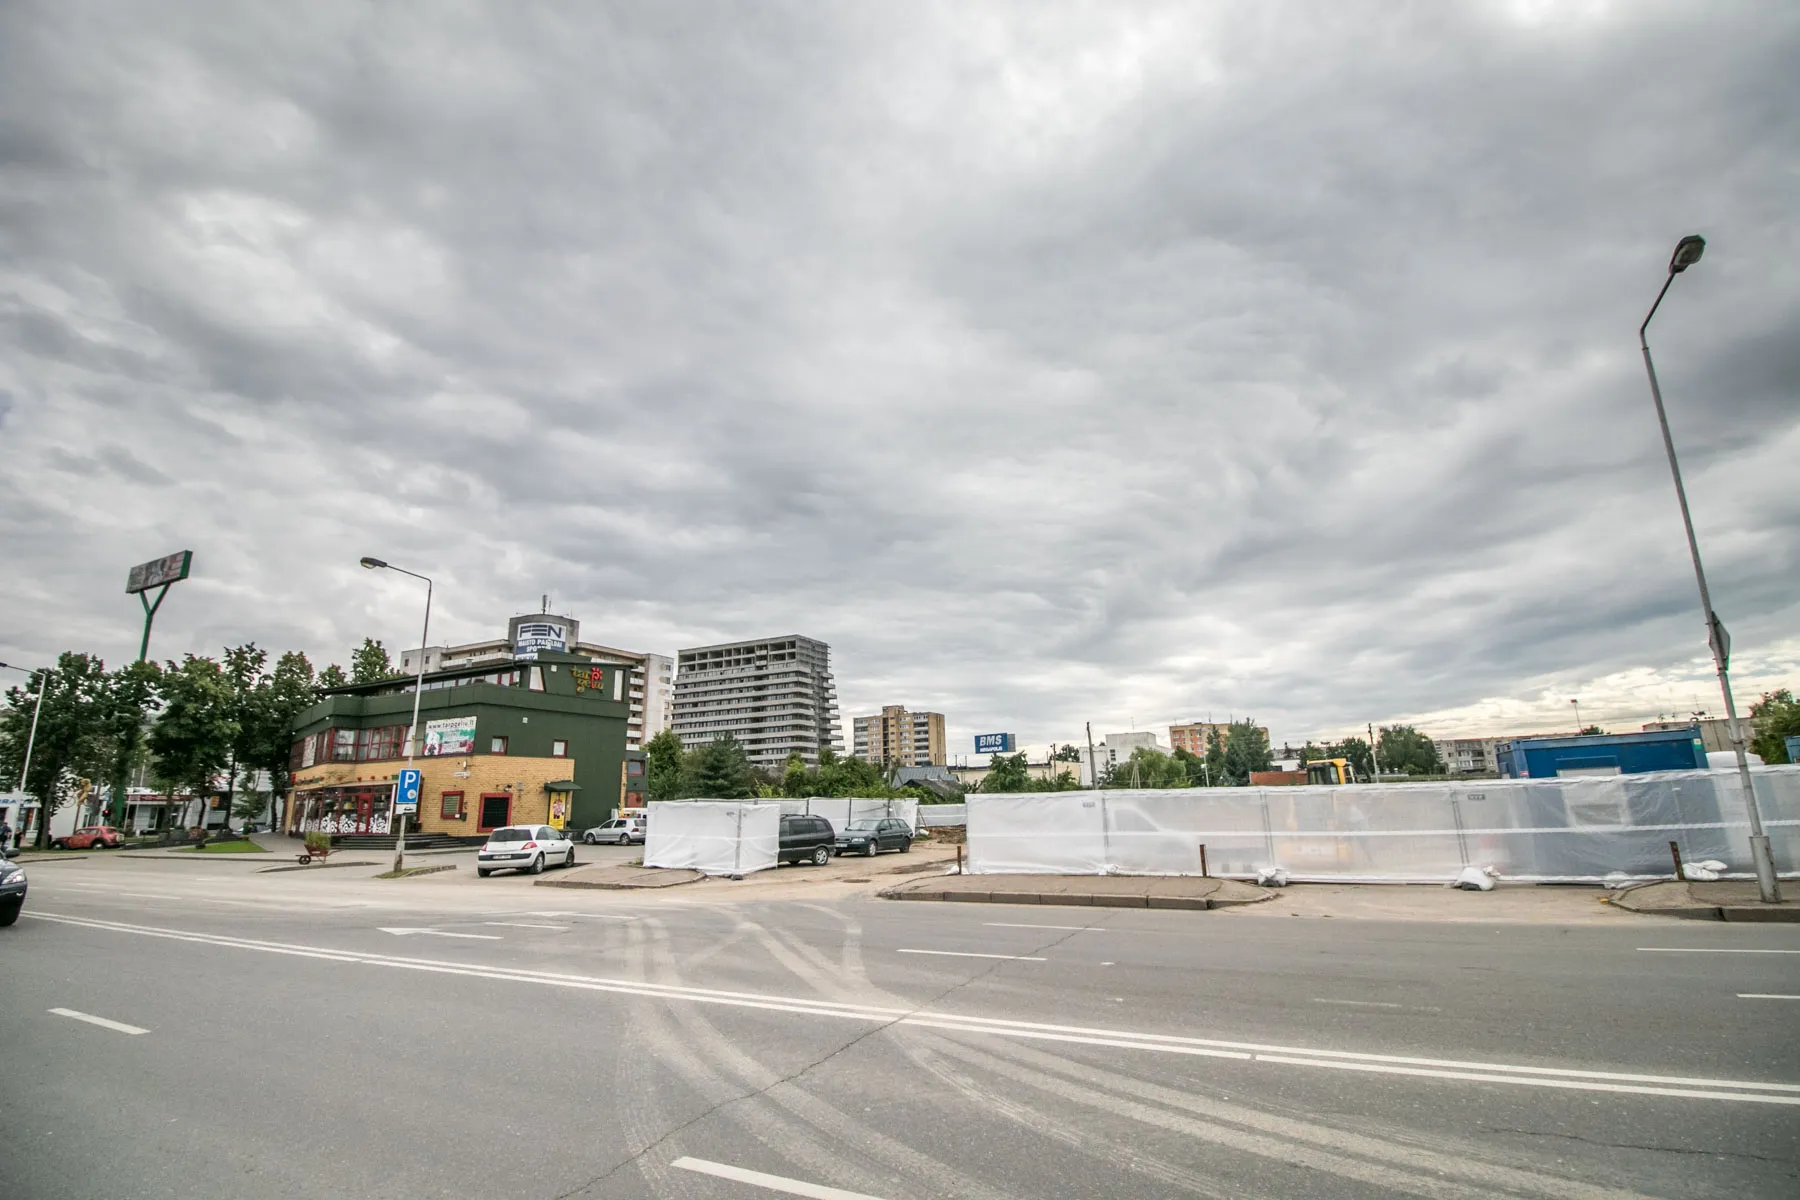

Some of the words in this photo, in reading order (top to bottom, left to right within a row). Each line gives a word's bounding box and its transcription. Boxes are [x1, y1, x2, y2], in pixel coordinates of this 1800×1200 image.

[520, 625, 562, 638] FEN
[537, 640, 562, 648] PAPLDAI
[980, 735, 1002, 746] BMS
[404, 772, 417, 788] P
